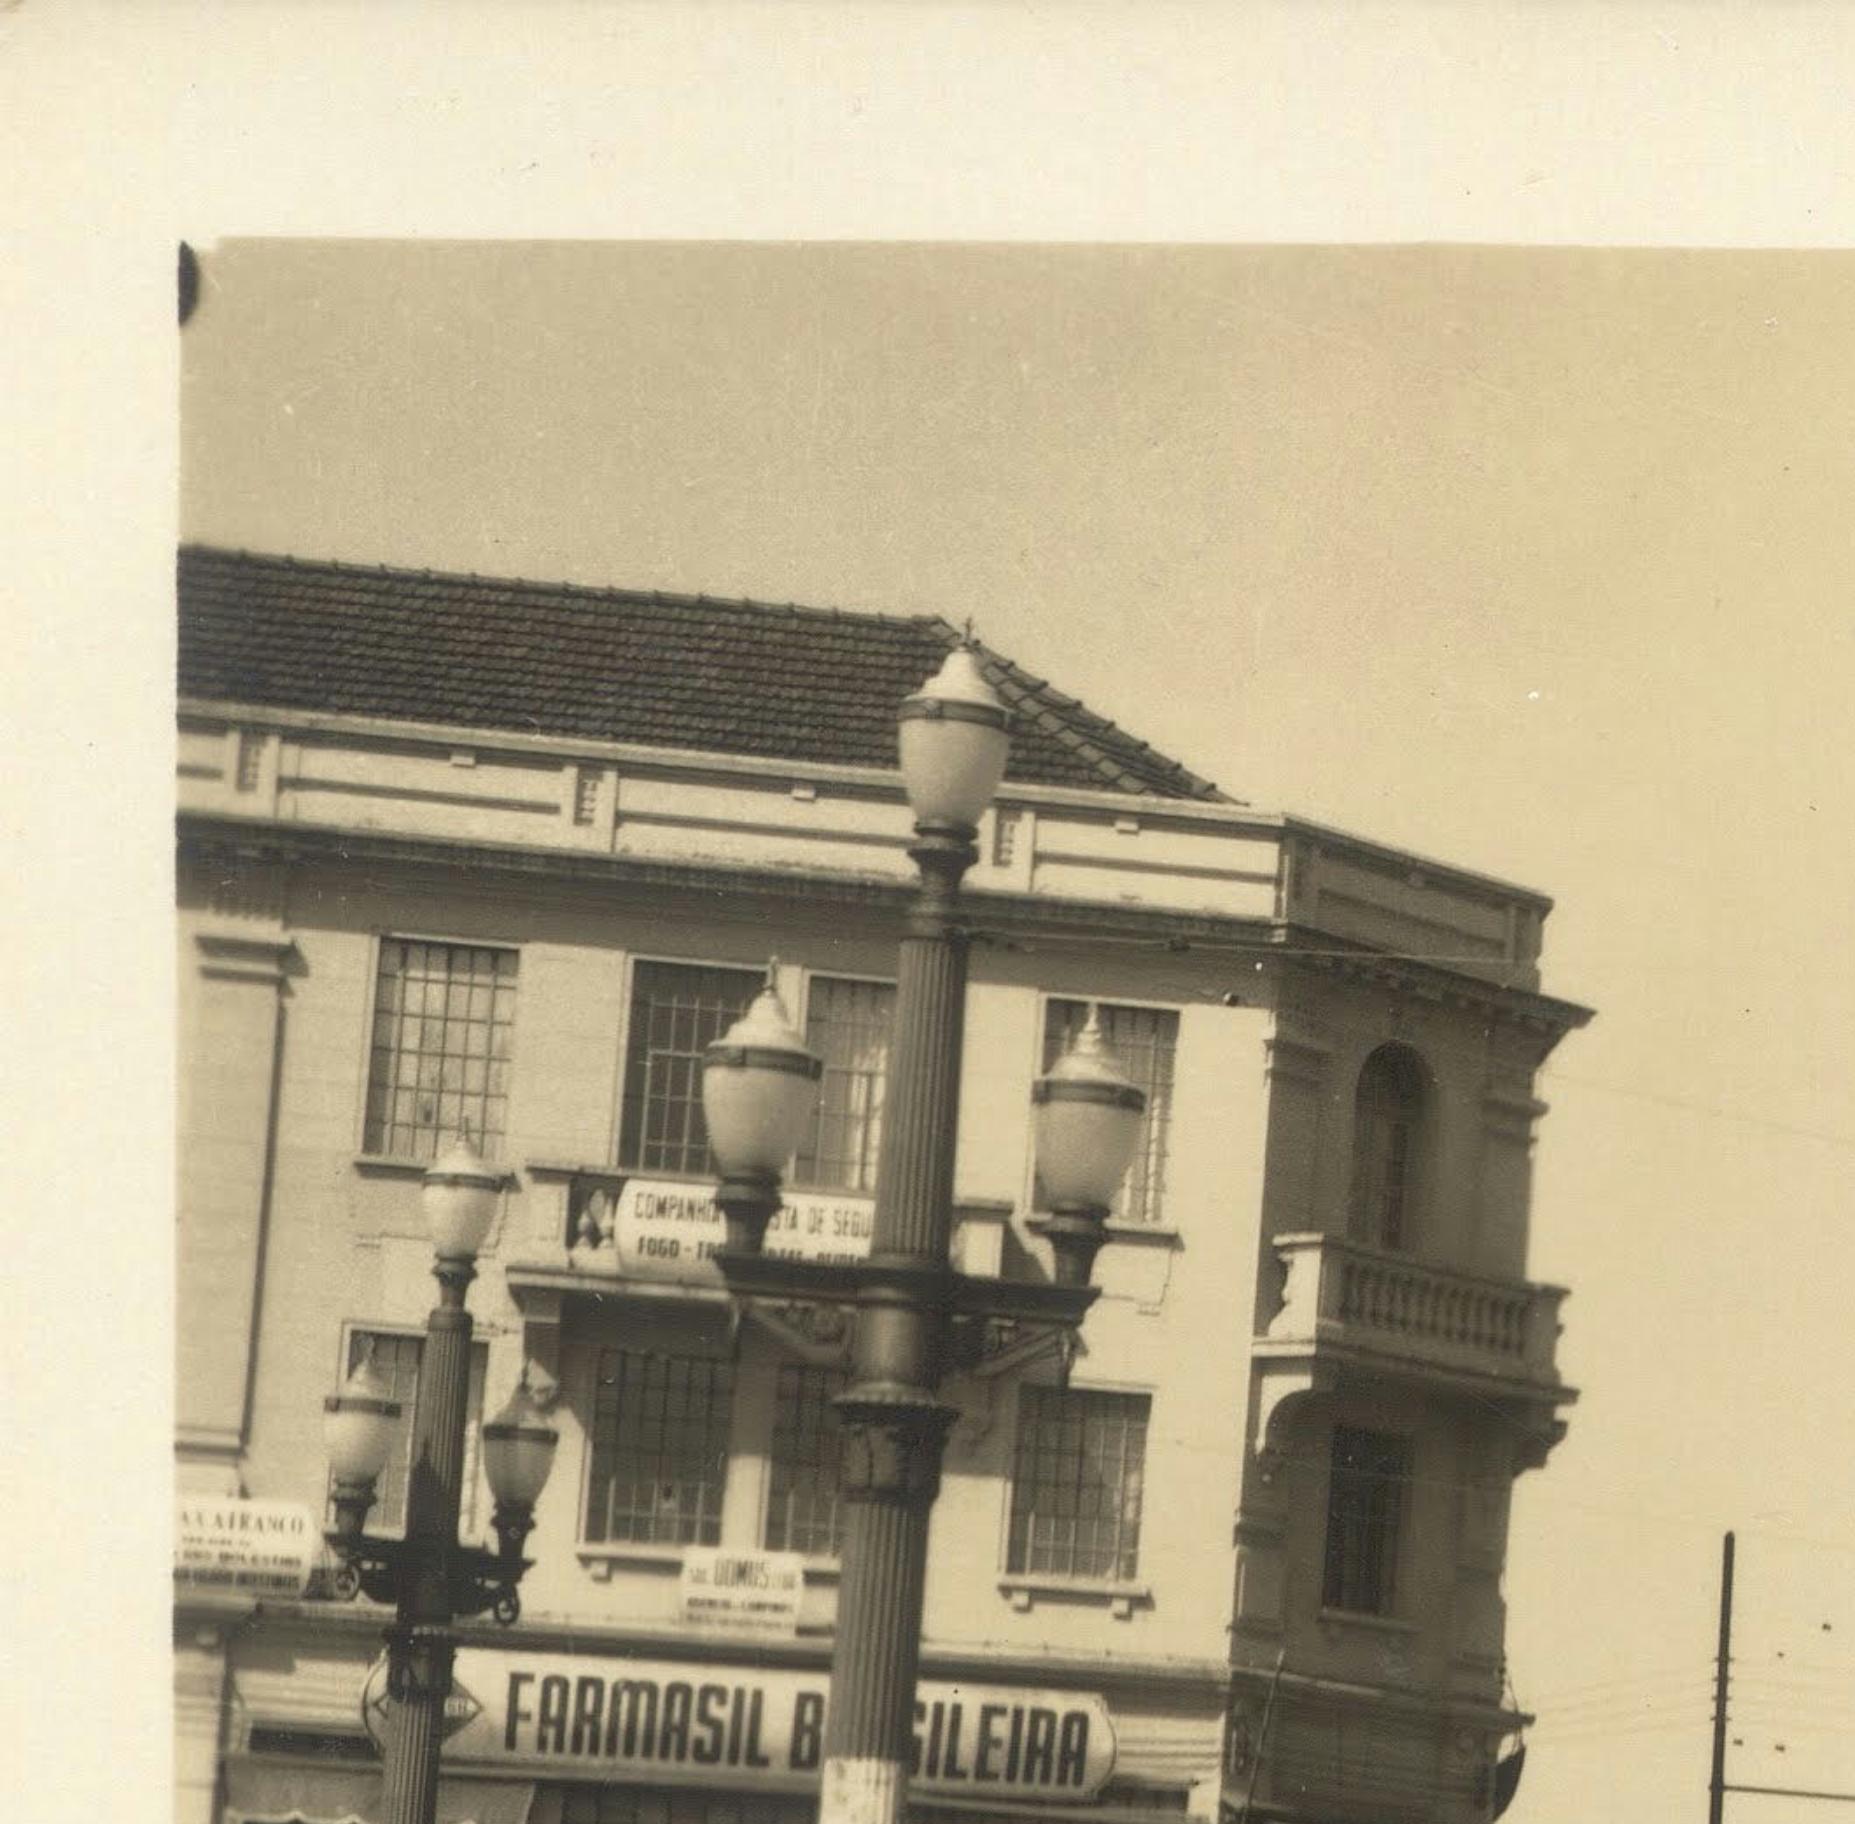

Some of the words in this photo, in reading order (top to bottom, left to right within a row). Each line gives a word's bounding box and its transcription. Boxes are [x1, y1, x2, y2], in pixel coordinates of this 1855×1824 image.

[807, 1206, 826, 1235] DE
[505, 1671, 771, 1769] FARMASIL
[789, 1689, 1091, 1788] BSILEIRA
